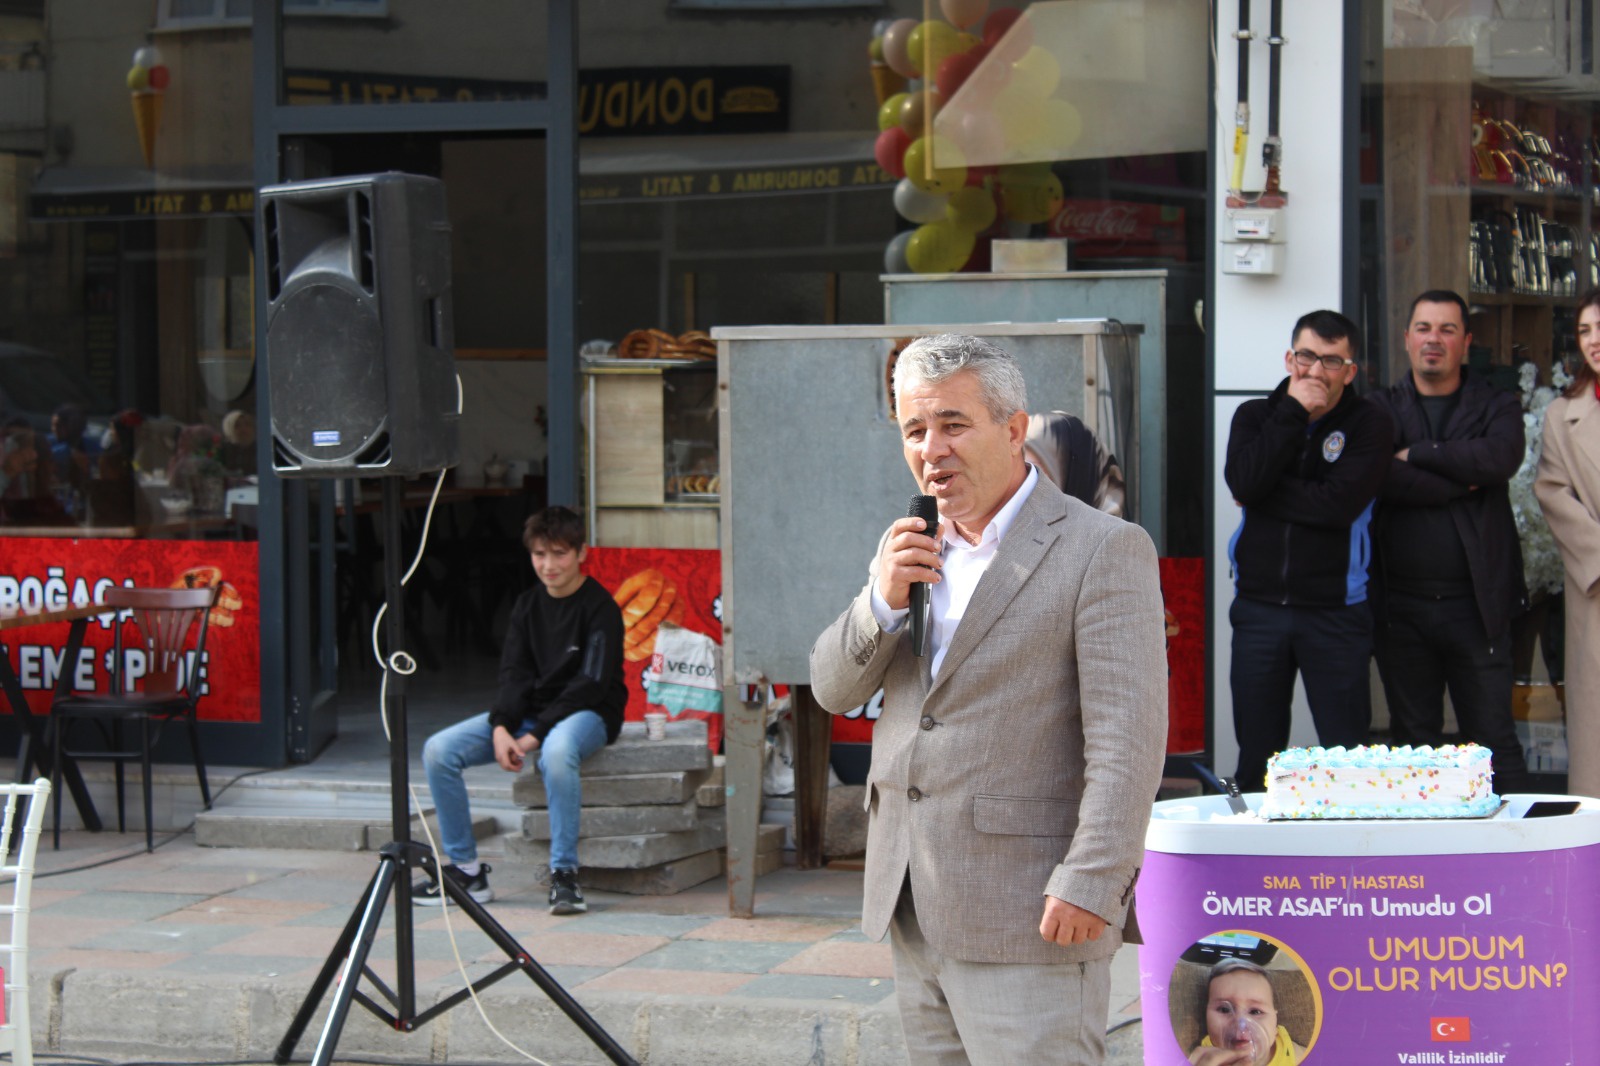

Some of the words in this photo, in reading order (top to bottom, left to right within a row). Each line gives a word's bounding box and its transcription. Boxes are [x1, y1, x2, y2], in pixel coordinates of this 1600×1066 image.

[1263, 876, 1301, 890] SMA
[1310, 873, 1336, 890] TİP
[1340, 876, 1347, 890] 1
[1353, 875, 1425, 890] HASTASI
[1203, 891, 1272, 916] ÖMER
[1371, 894, 1456, 917] Umudu
[1464, 893, 1492, 916] Ol
[1368, 935, 1525, 962] UMUDUM
[1328, 966, 1420, 992] OLUR
[1430, 962, 1568, 991] MUSUN?
[1398, 1052, 1445, 1065] Valilik
[1448, 1050, 1506, 1065] İzinlidir
